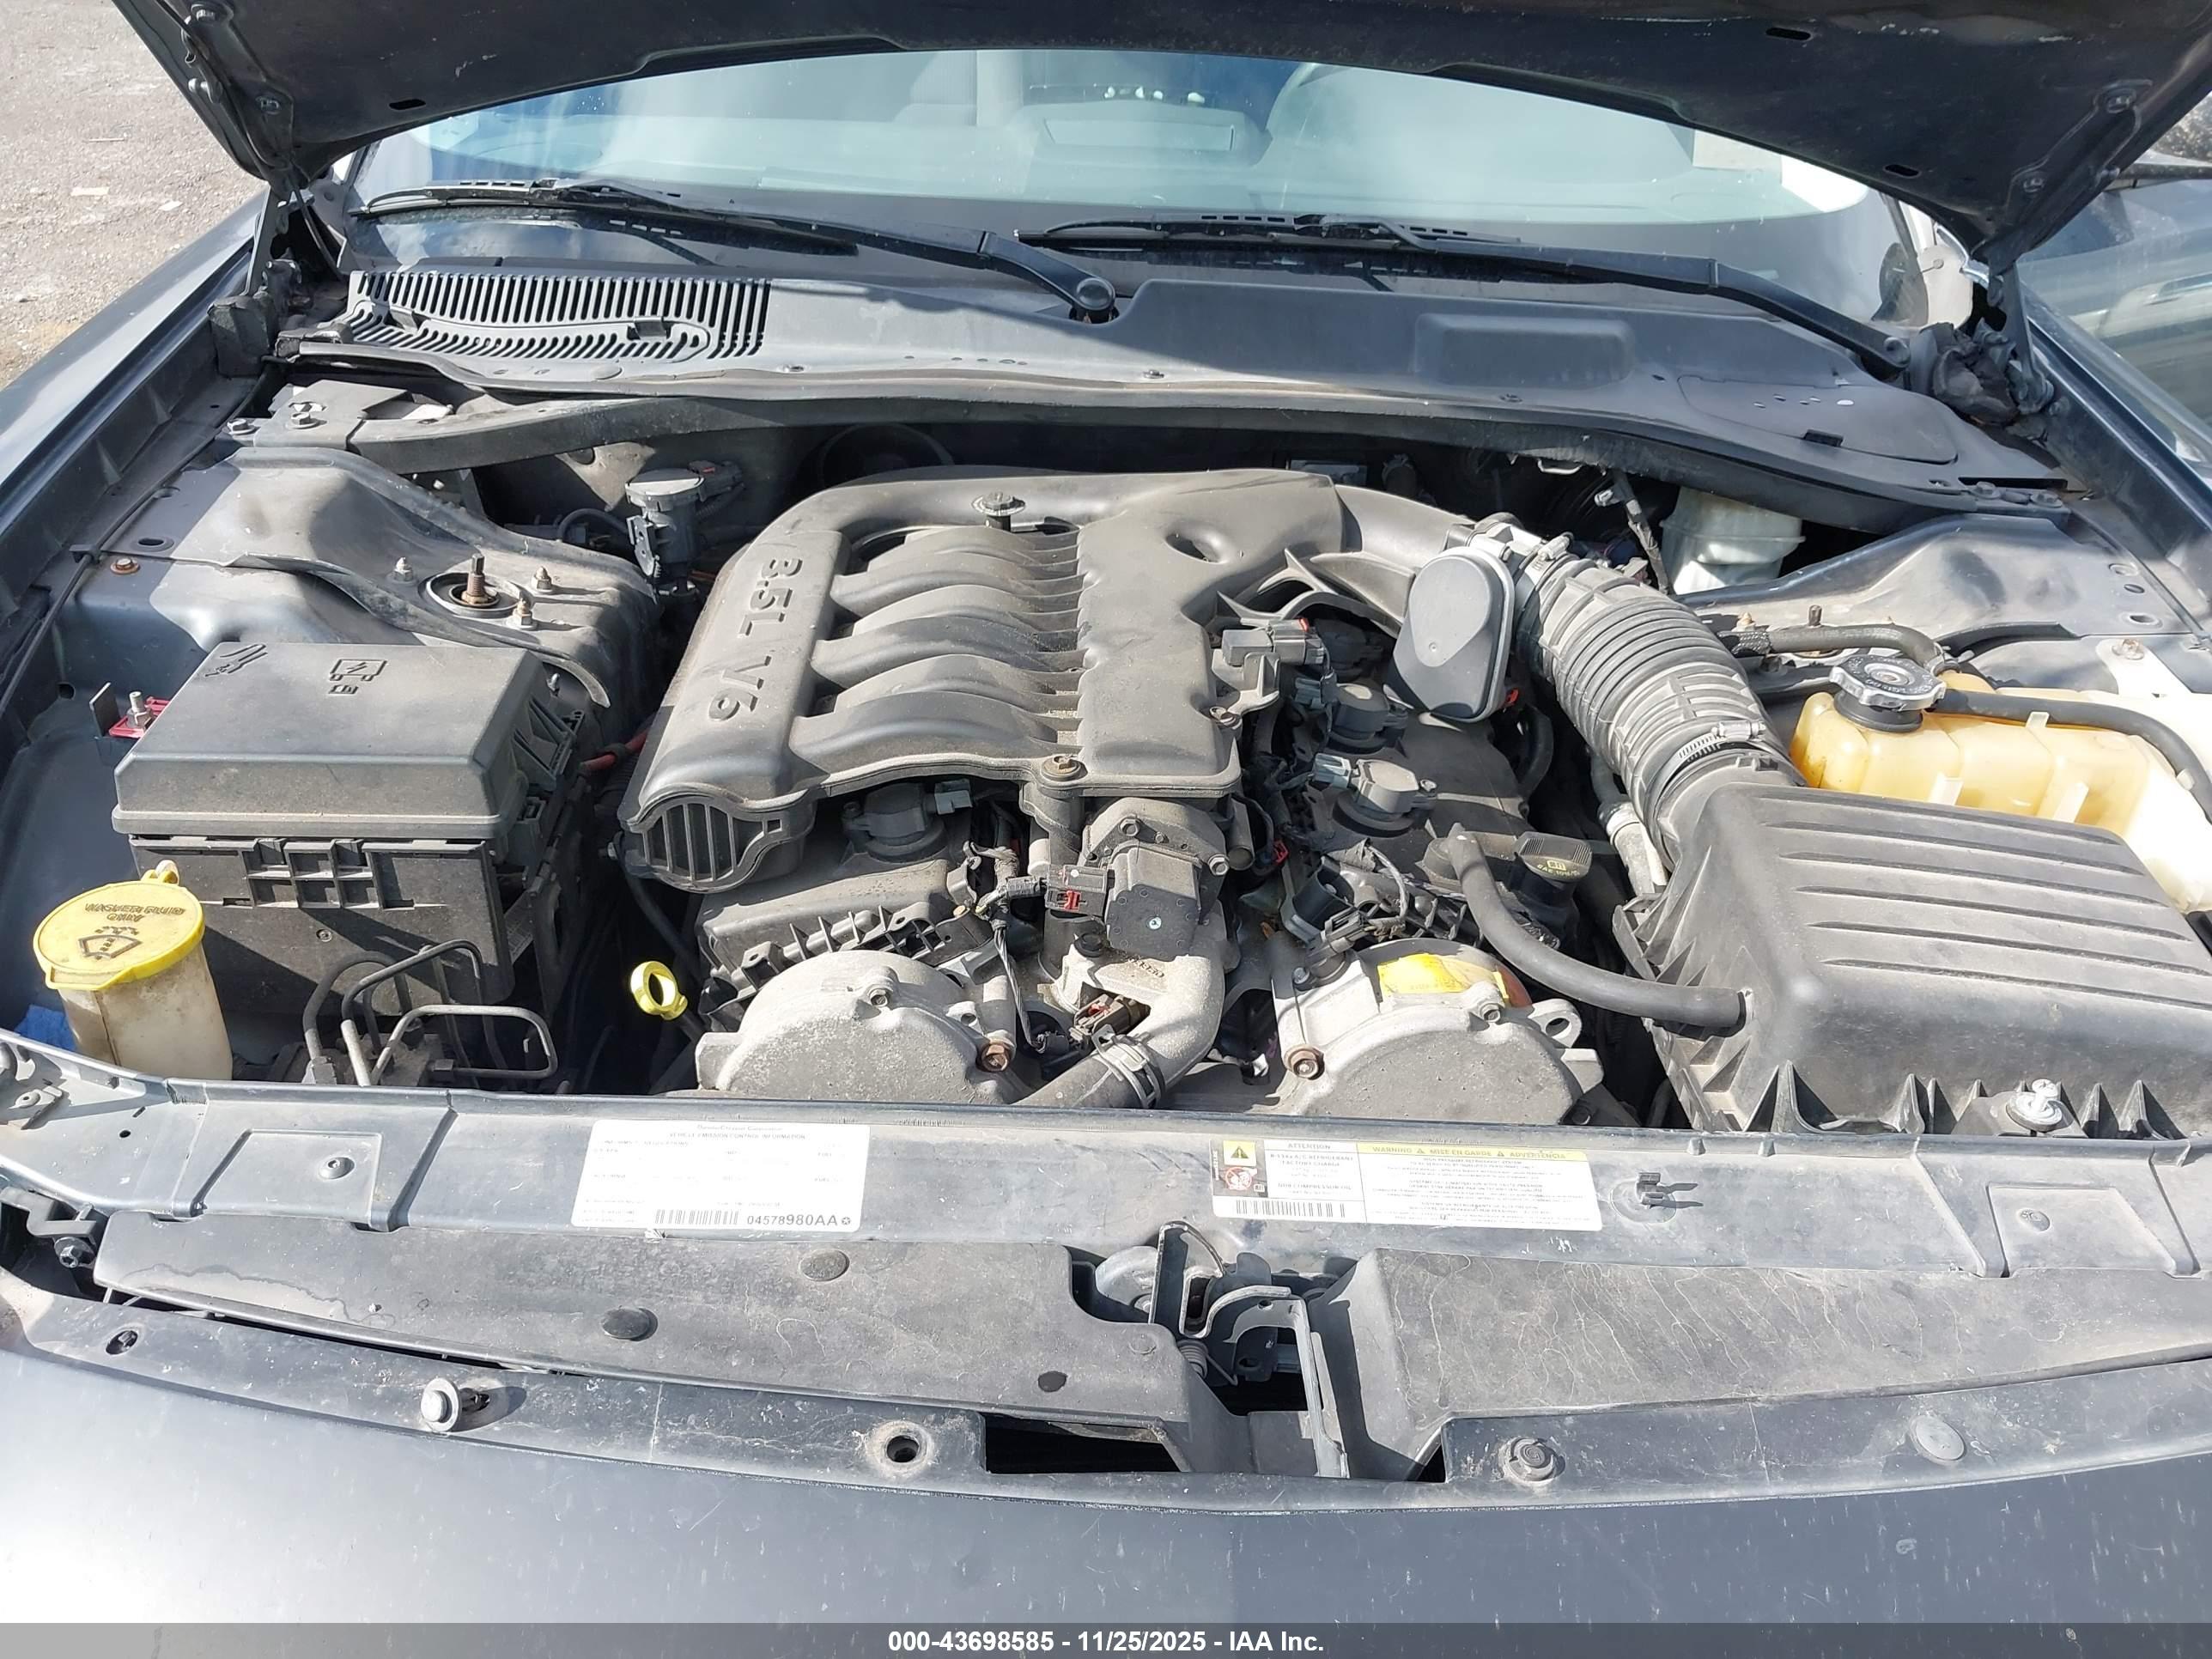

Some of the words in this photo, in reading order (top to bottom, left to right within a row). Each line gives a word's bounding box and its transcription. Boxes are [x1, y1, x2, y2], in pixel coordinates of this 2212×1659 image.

[738, 557, 803, 636] 3.5L
[708, 654, 774, 721] V6
[143, 905, 185, 915] FLUID
[106, 913, 146, 922] ONLY
[746, 1213, 839, 1227] 04578980AA
